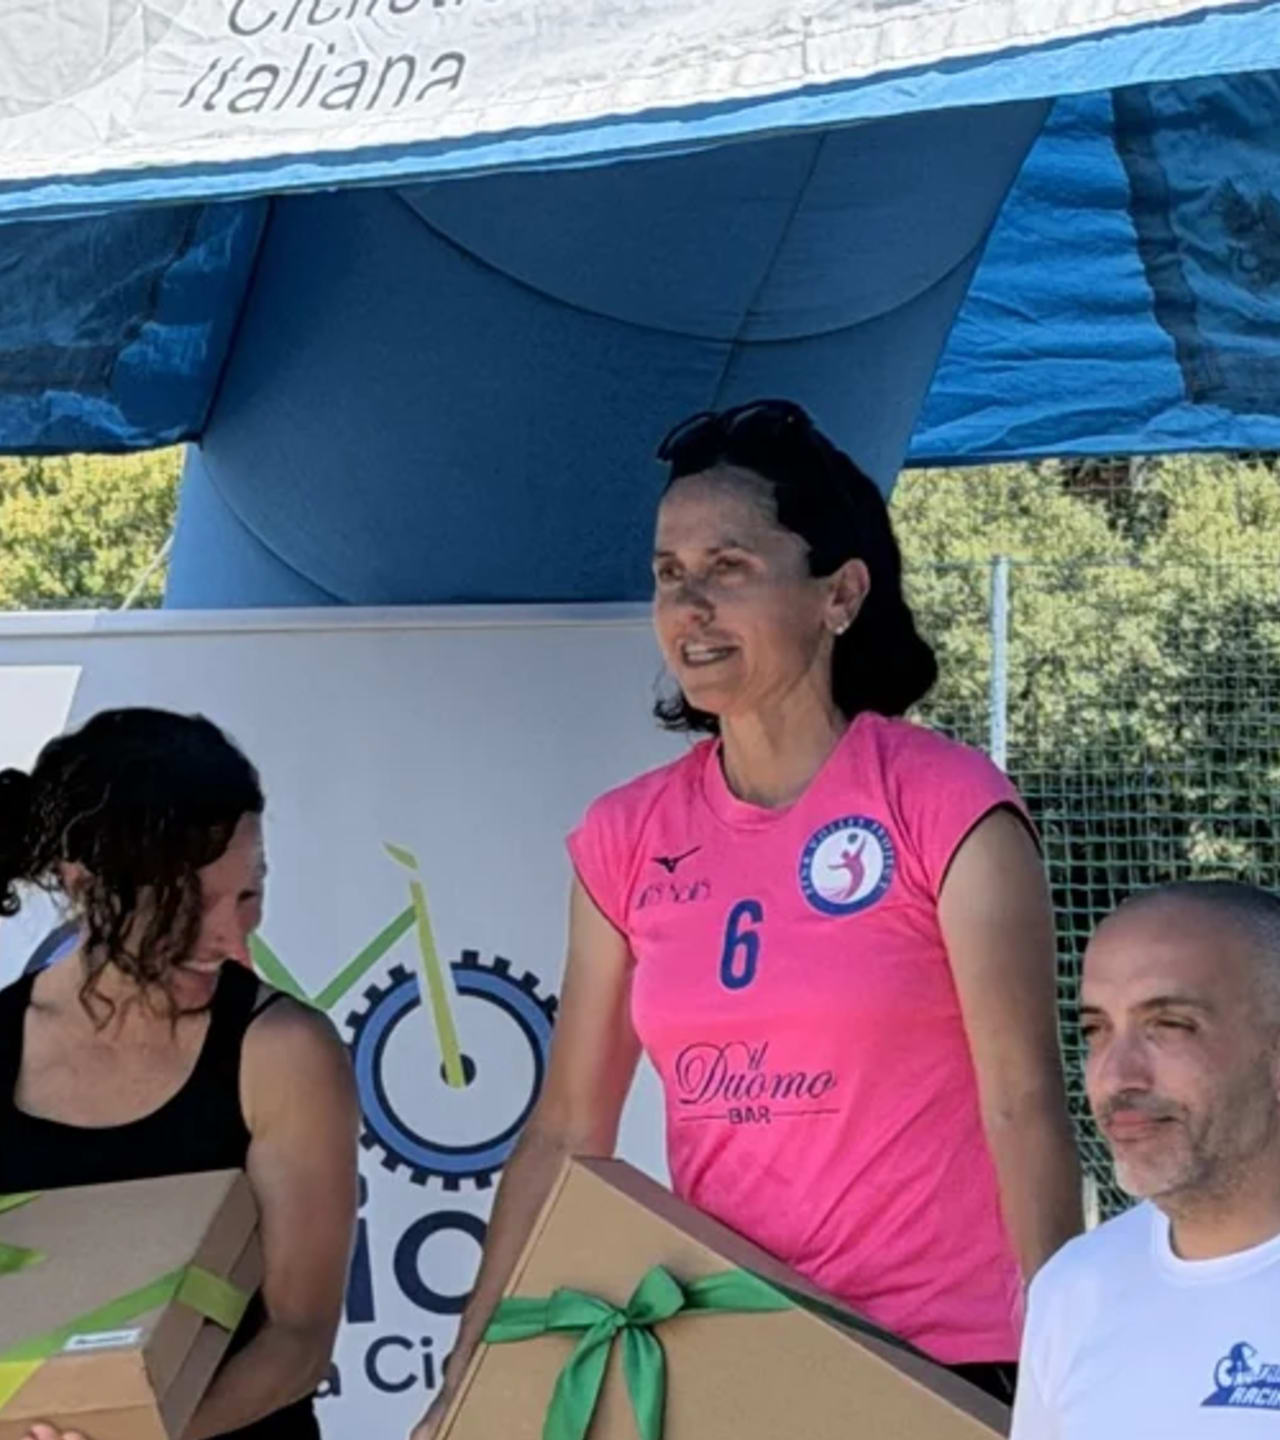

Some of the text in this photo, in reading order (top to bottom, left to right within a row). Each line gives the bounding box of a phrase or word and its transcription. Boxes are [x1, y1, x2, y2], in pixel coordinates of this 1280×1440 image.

[179, 43, 467, 113] Italiana
[720, 899, 764, 990] 6
[676, 1042, 837, 1104] Duomo
[729, 1106, 771, 1125] BAR
[365, 1335, 452, 1394] Ci
